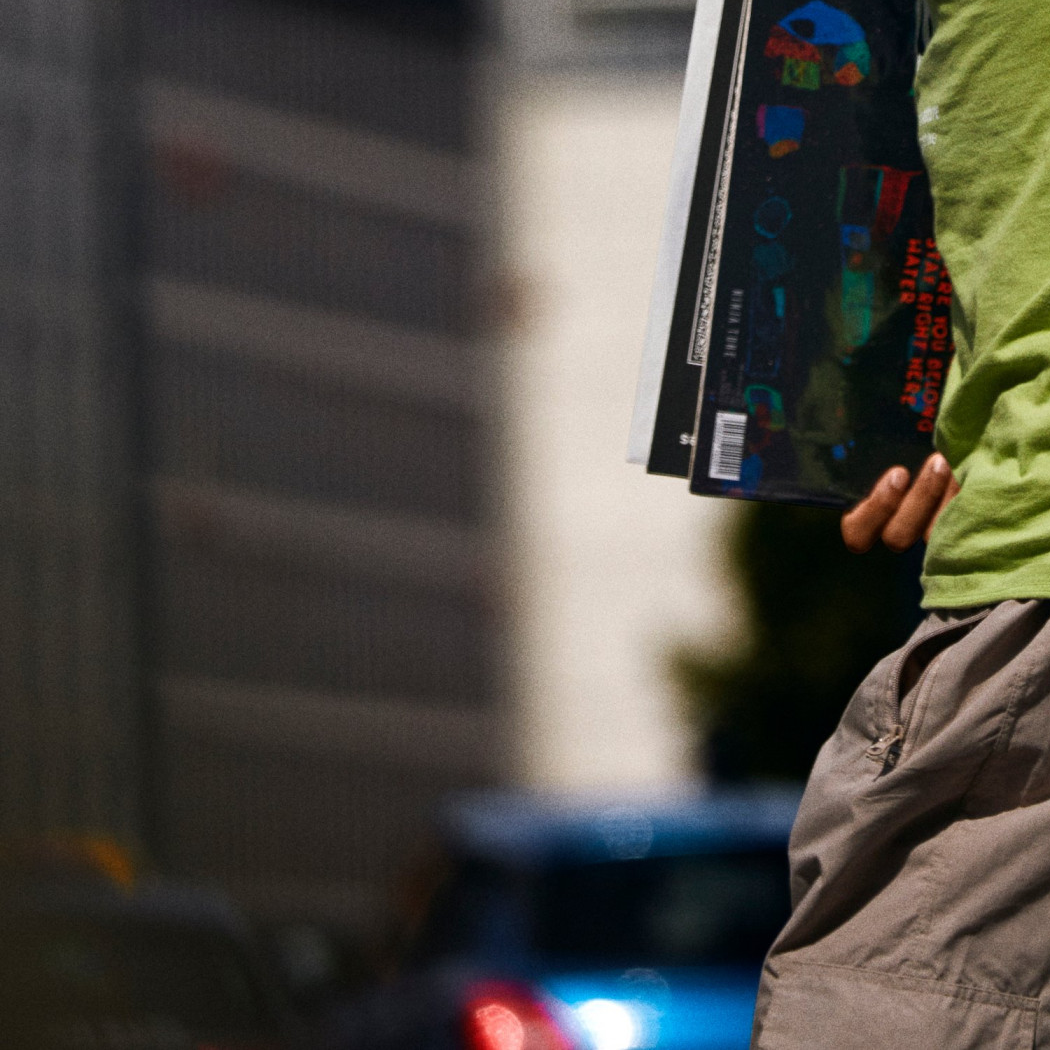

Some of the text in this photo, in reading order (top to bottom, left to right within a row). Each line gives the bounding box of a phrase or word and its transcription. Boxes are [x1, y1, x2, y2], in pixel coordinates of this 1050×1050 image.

[900, 238, 941, 406] STAY RIGHT HERE
[931, 316, 949, 351] YOU
[917, 358, 943, 433] BELONG
